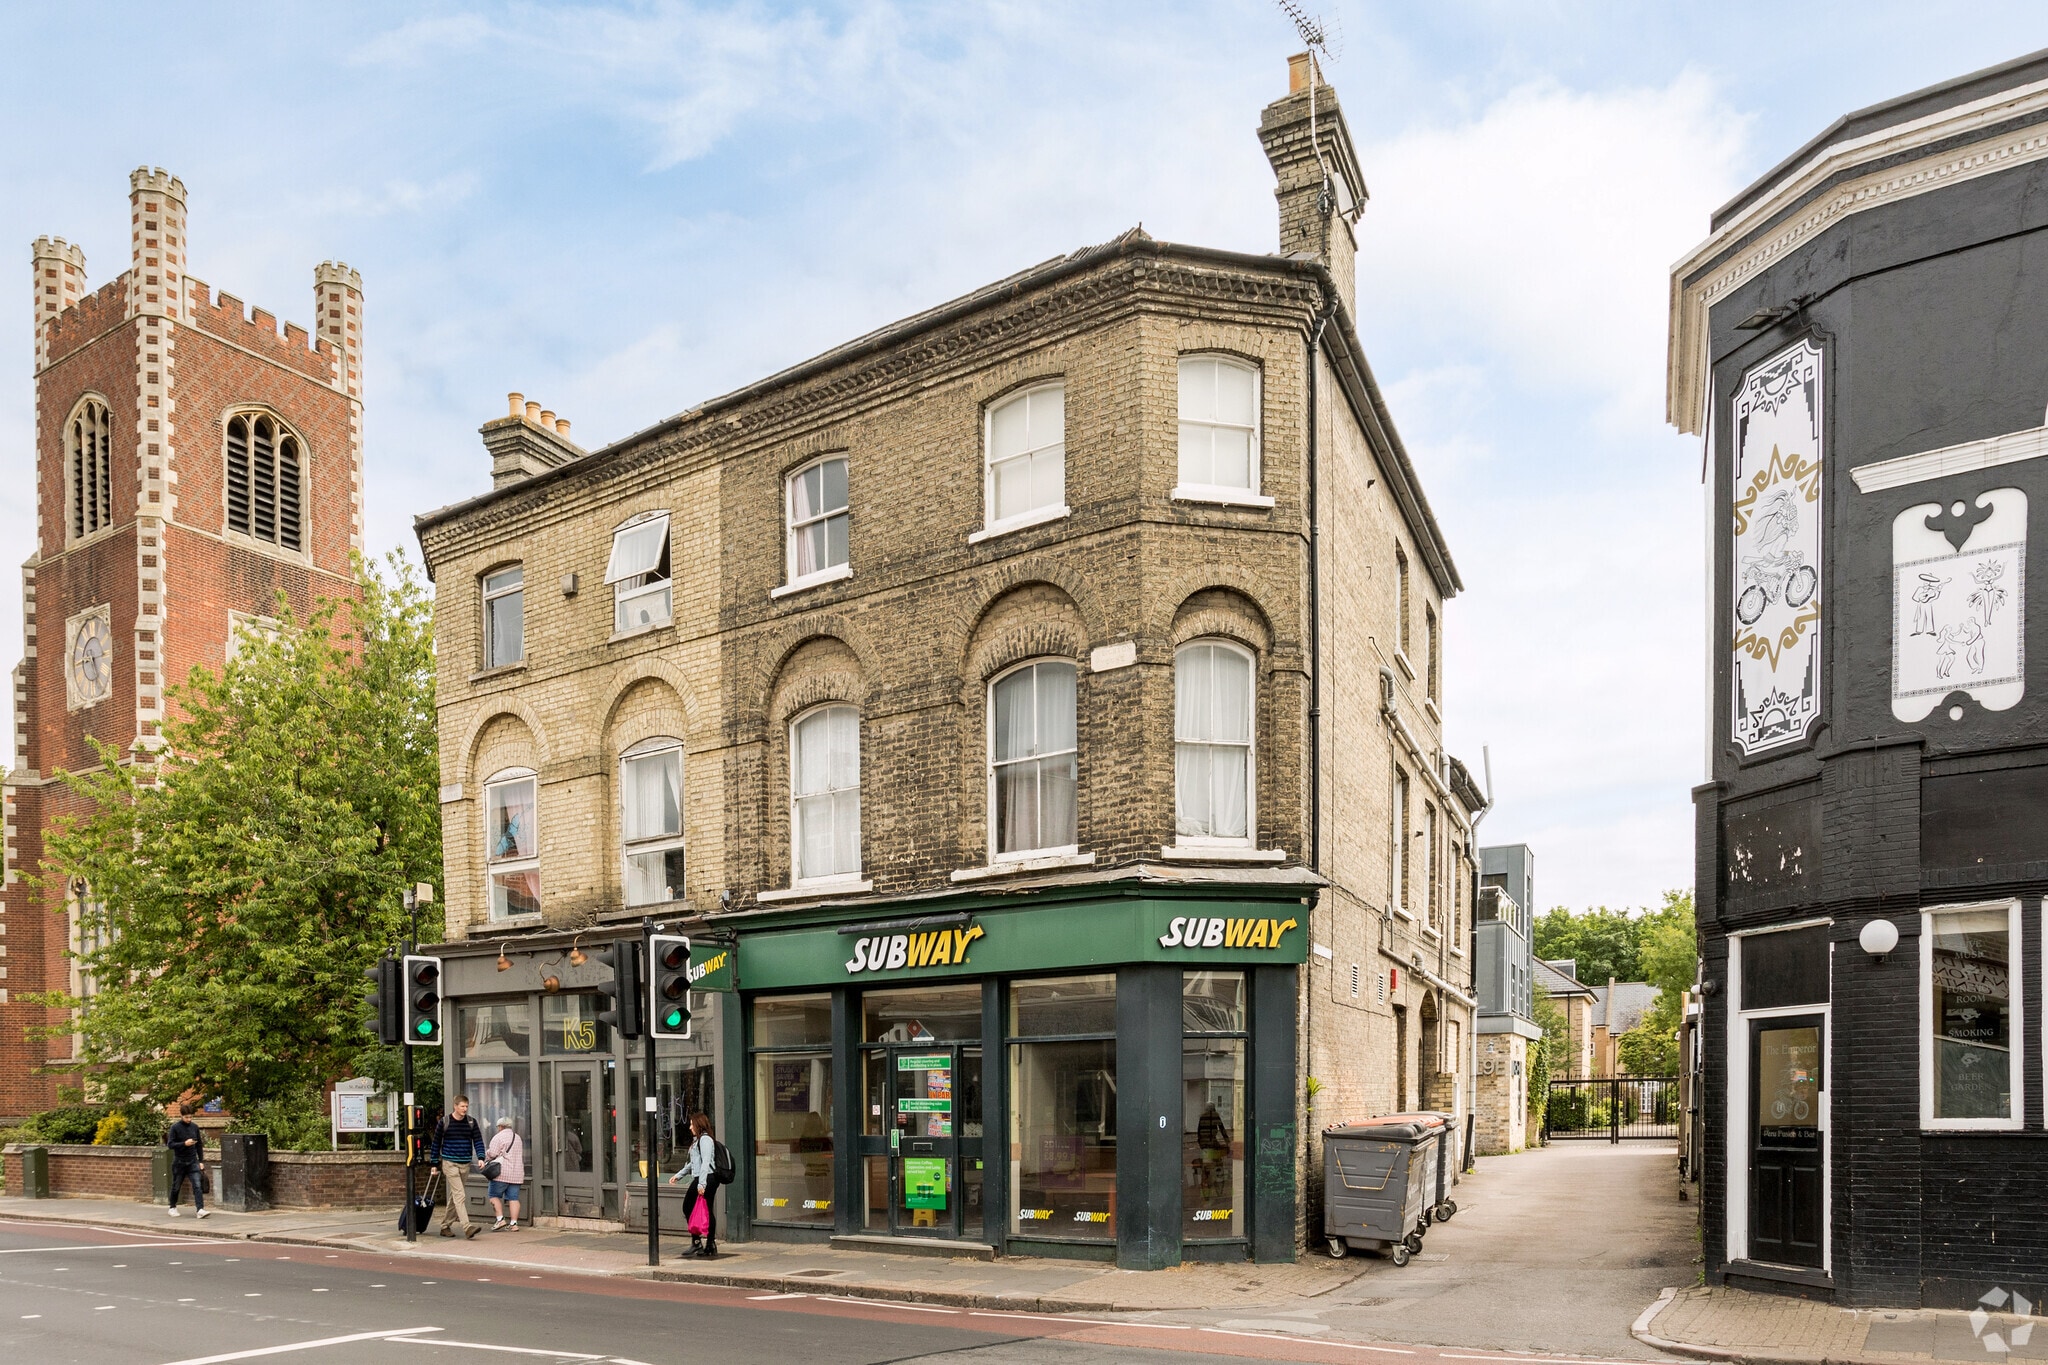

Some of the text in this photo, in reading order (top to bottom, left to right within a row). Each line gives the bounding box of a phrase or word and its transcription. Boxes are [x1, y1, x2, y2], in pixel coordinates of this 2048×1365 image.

[1159, 916, 1298, 948] SUBWAY
[845, 924, 985, 974] SUBWAY
[687, 951, 727, 983] SUBWAY
[1956, 994, 1986, 1003] ROOM
[564, 1017, 596, 1049] K5
[1948, 1028, 1994, 1037] SMOKING
[1765, 1043, 1817, 1055] The Emperor
[1959, 1072, 1984, 1081] BEER
[762, 1197, 789, 1207] SUBWAY
[803, 1199, 831, 1209] SUBWAY
[1018, 1209, 1054, 1220] SUBWAY
[1074, 1211, 1111, 1223] SUBWAY
[1193, 1209, 1233, 1221] SUBWAY
